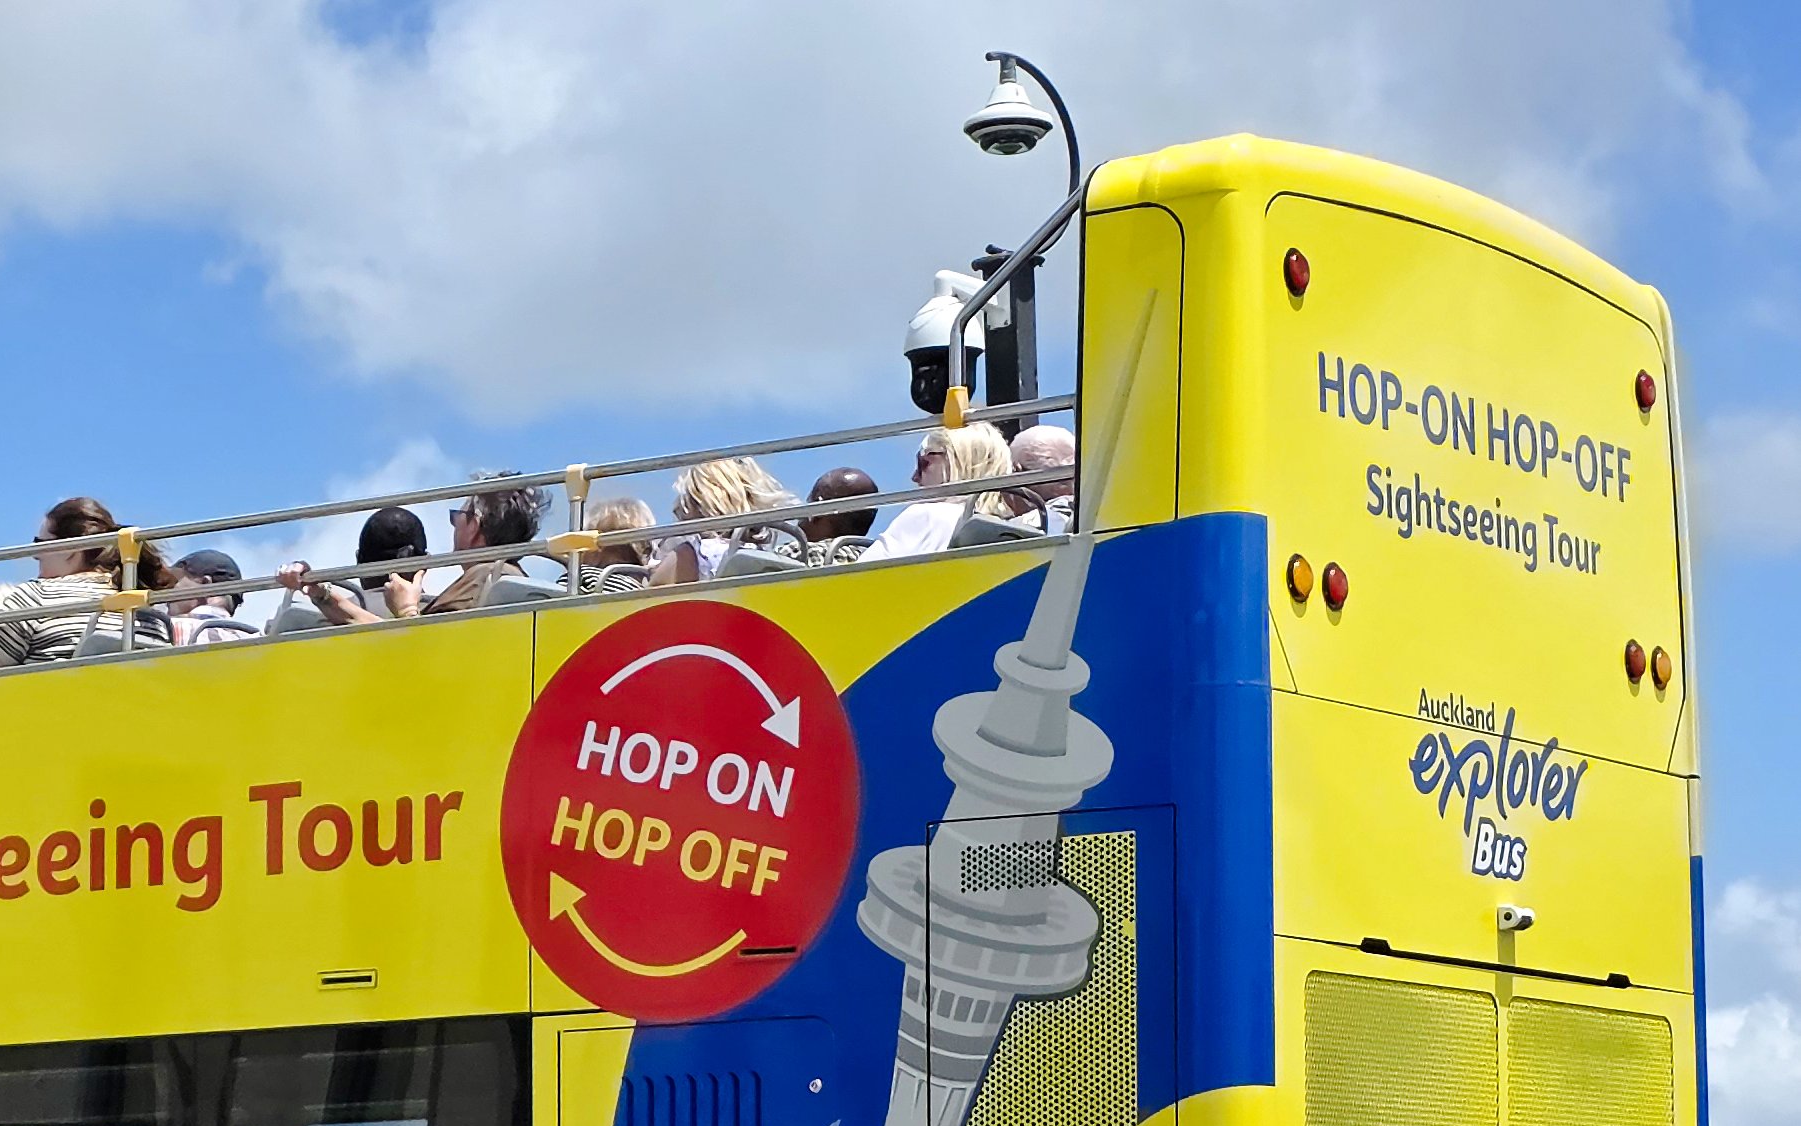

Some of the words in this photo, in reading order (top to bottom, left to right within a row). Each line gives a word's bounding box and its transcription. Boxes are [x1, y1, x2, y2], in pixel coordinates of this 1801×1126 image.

[1317, 351, 1476, 456] HOP-ON
[1486, 402, 1632, 503] HOP-OFF
[1365, 463, 1538, 573] Sightseeing
[1543, 513, 1602, 575] Tour
[1417, 687, 1496, 732] Auckland
[576, 719, 700, 791] HOP
[706, 751, 796, 818] ON
[1408, 707, 1589, 837] explorer
[248, 781, 466, 877] Tour
[550, 795, 672, 867] HOP
[678, 830, 789, 897] OFF
[1471, 816, 1527, 881] Bus
